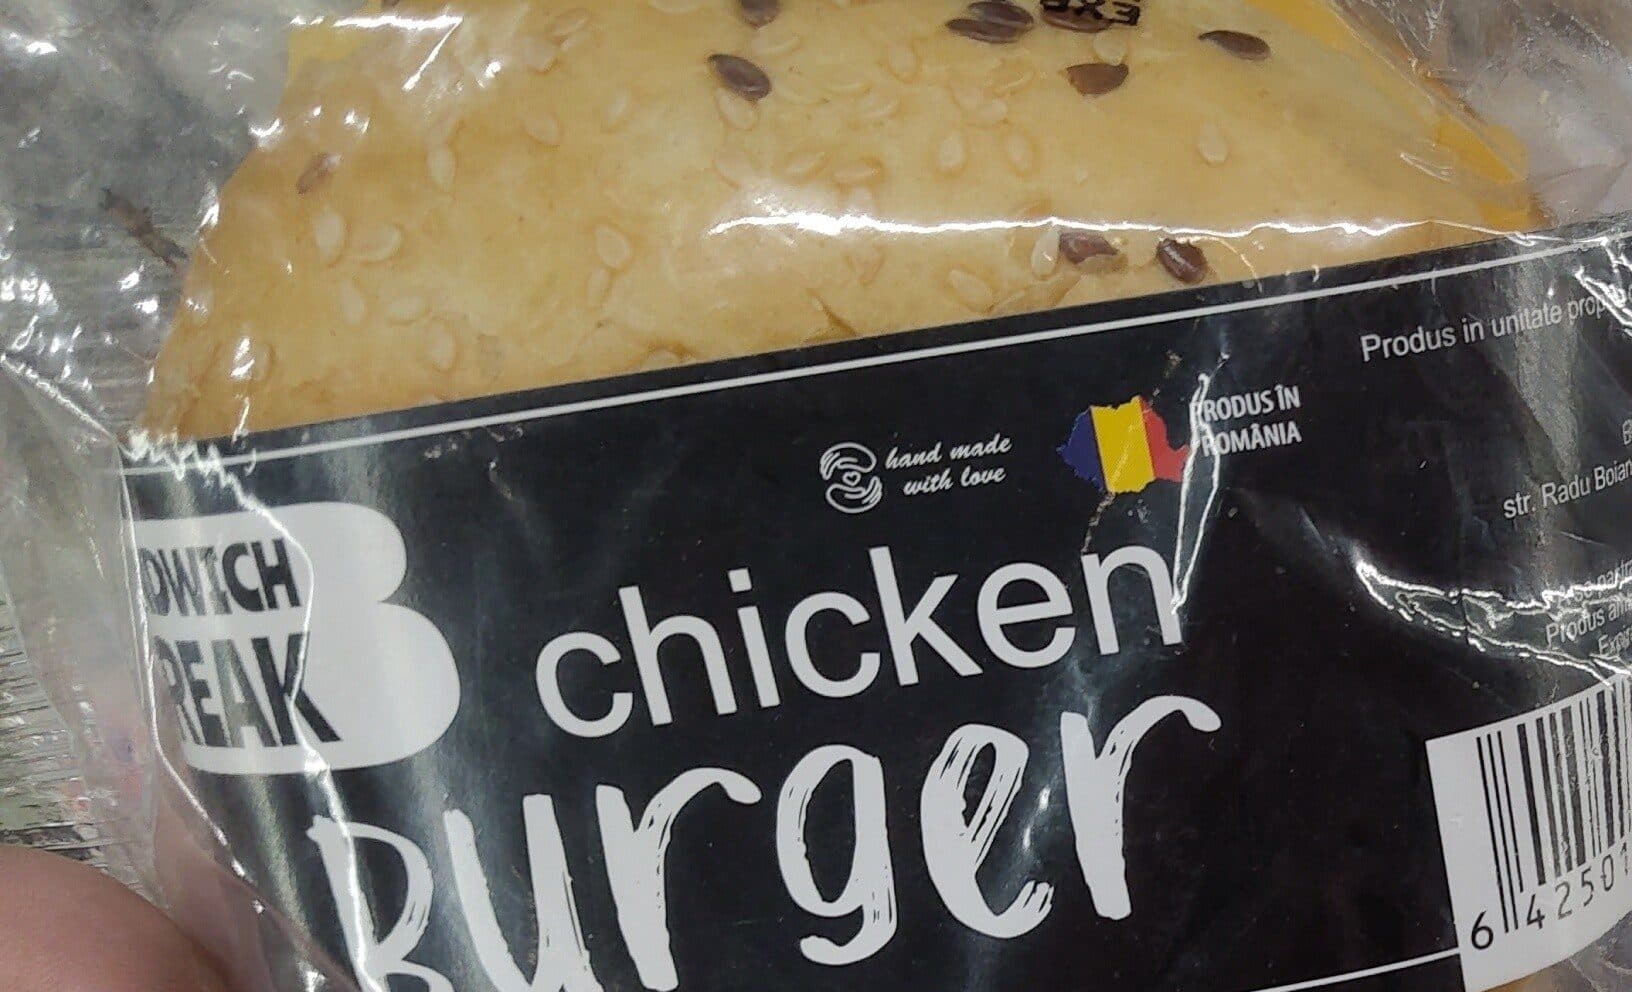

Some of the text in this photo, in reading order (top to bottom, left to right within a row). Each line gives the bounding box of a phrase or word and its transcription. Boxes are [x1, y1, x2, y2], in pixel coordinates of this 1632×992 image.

[1360, 326, 1456, 362] Produs
[1462, 319, 1485, 344] in
[1490, 301, 1564, 338] unitate
[1274, 384, 1301, 411] ÎN
[885, 432, 1013, 470] hand made
[1201, 420, 1302, 458] ROMÂNIA
[903, 465, 1006, 496] with love
[1503, 490, 1537, 519] str.
[1541, 474, 1592, 508] Radu
[535, 545, 1185, 738] chicken
[1546, 609, 1606, 645] Produs
[1471, 910, 1494, 951] 6
